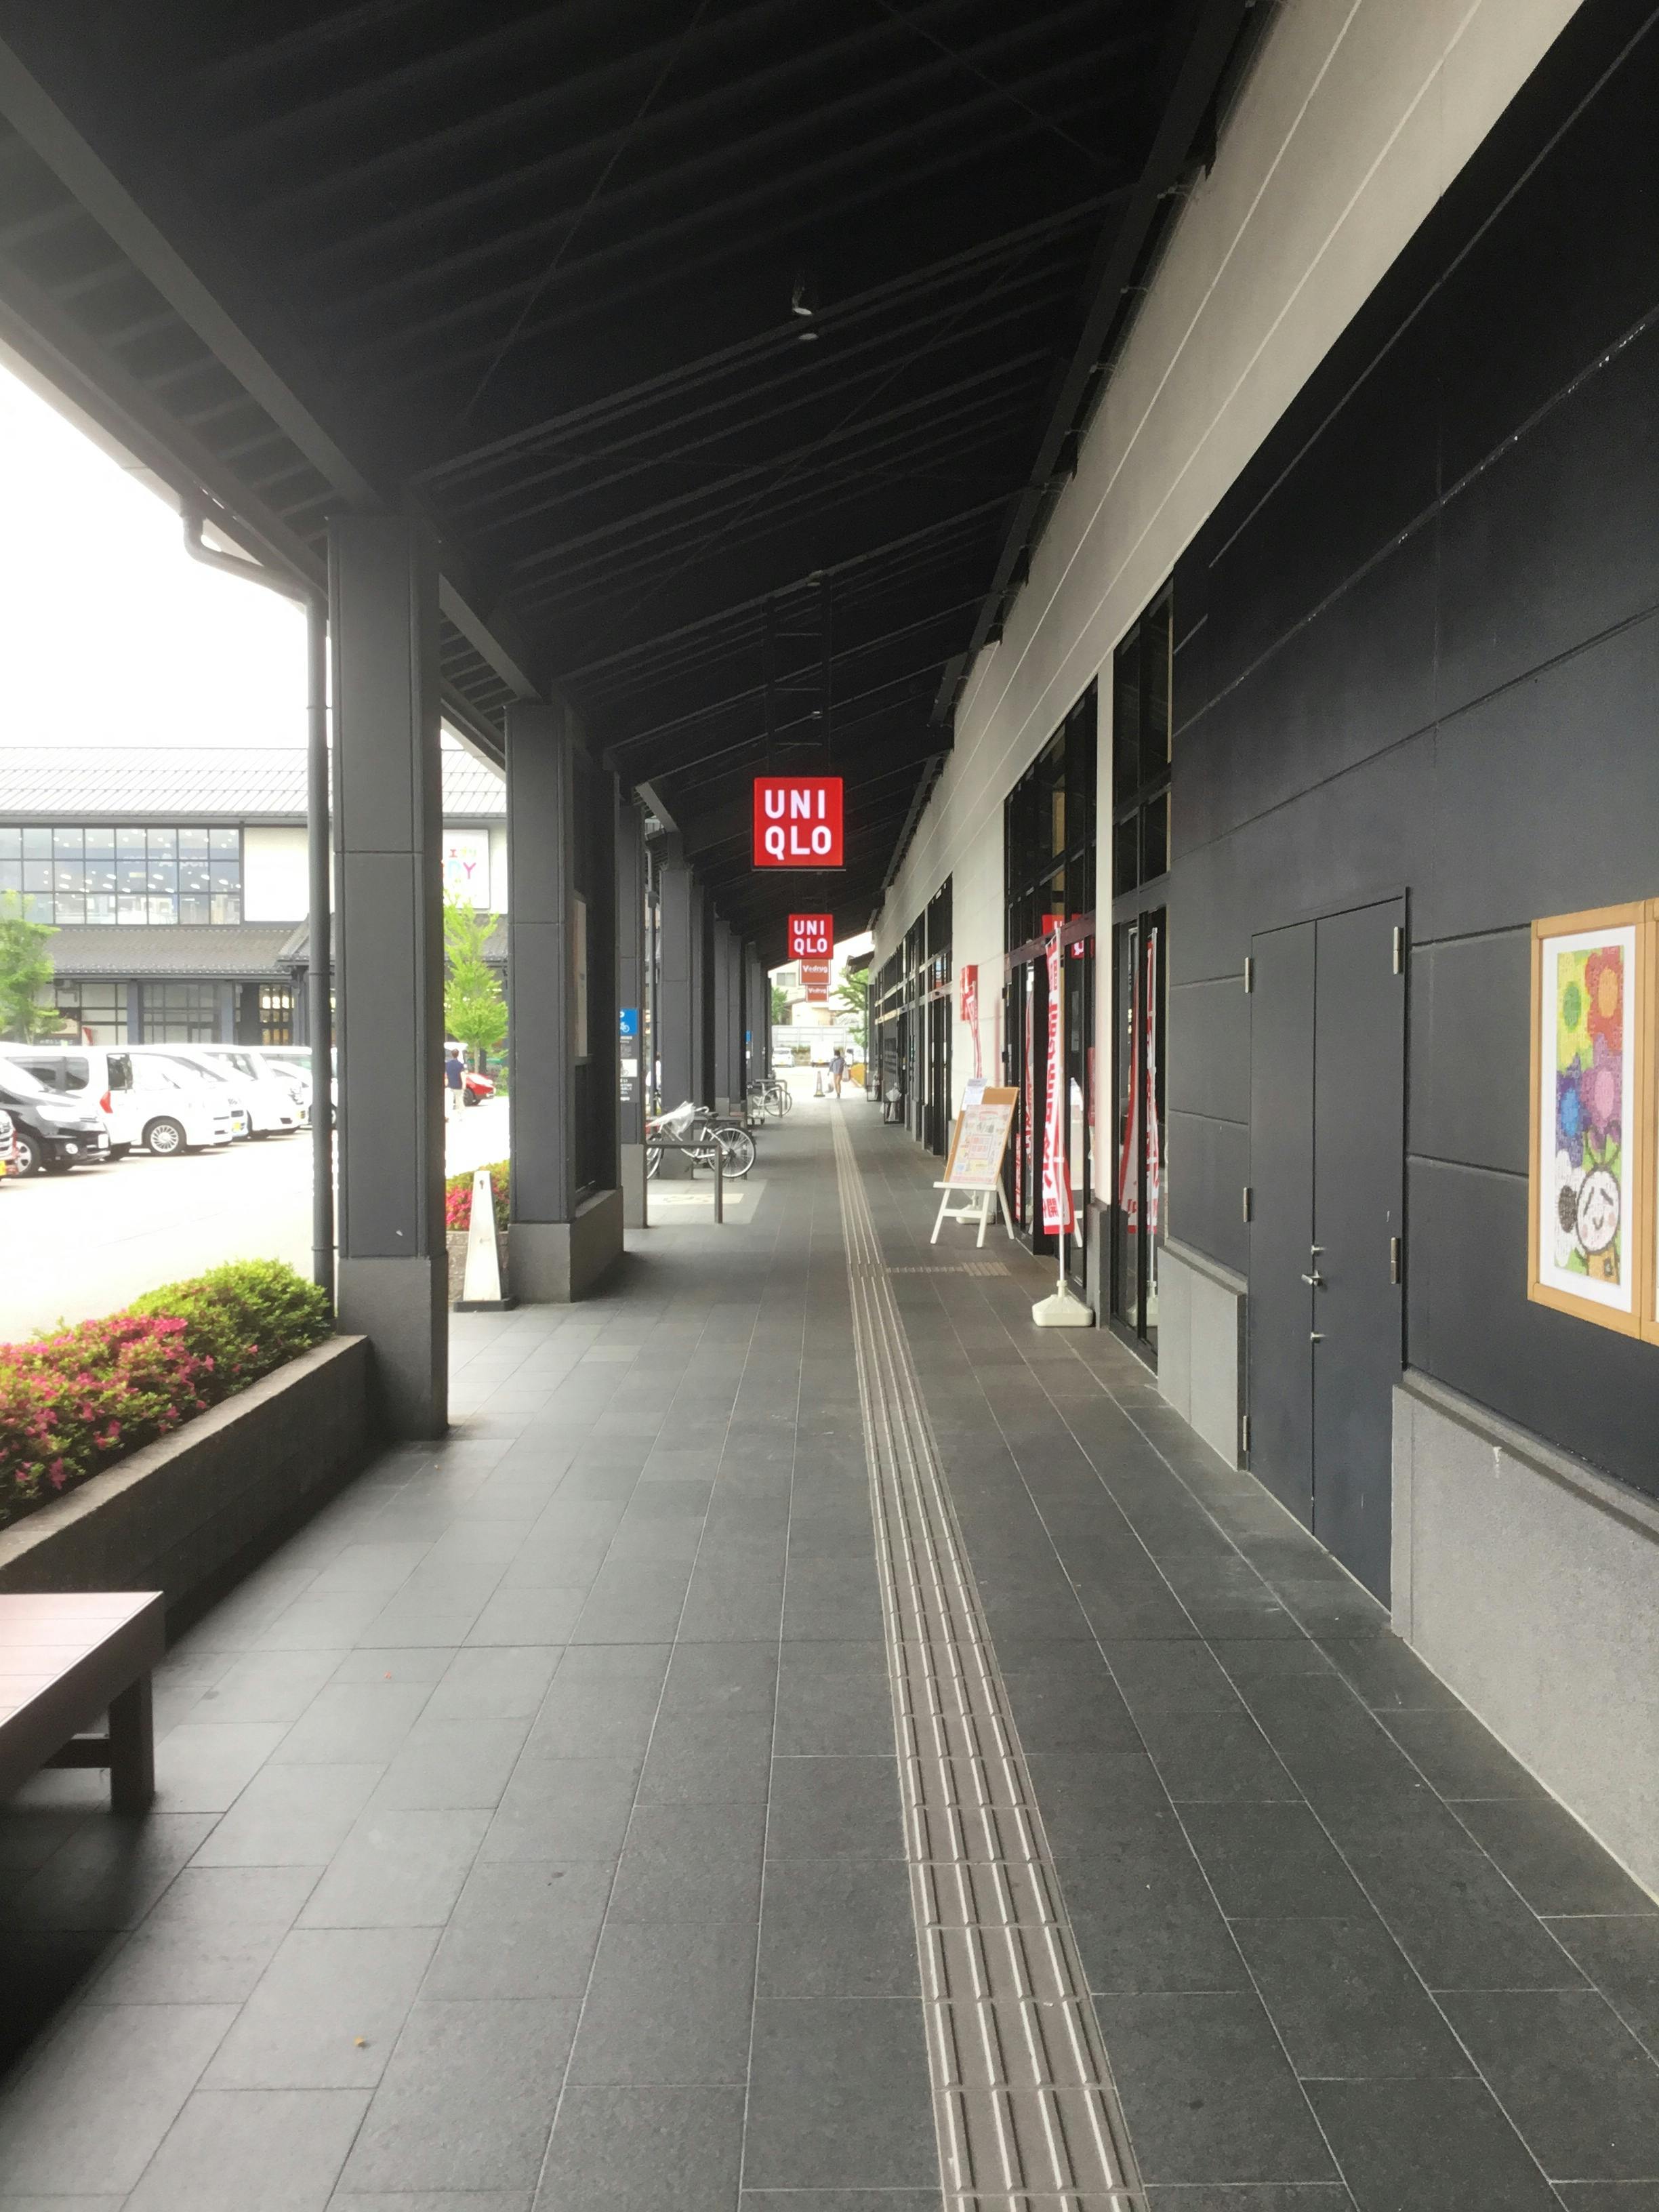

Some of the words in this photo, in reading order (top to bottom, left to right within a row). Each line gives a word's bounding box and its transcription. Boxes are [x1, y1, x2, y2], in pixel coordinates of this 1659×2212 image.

[764, 790, 825, 819] UNI
[764, 825, 832, 861] QLO
[794, 920, 825, 935] UNI
[794, 938, 827, 955] QLO
